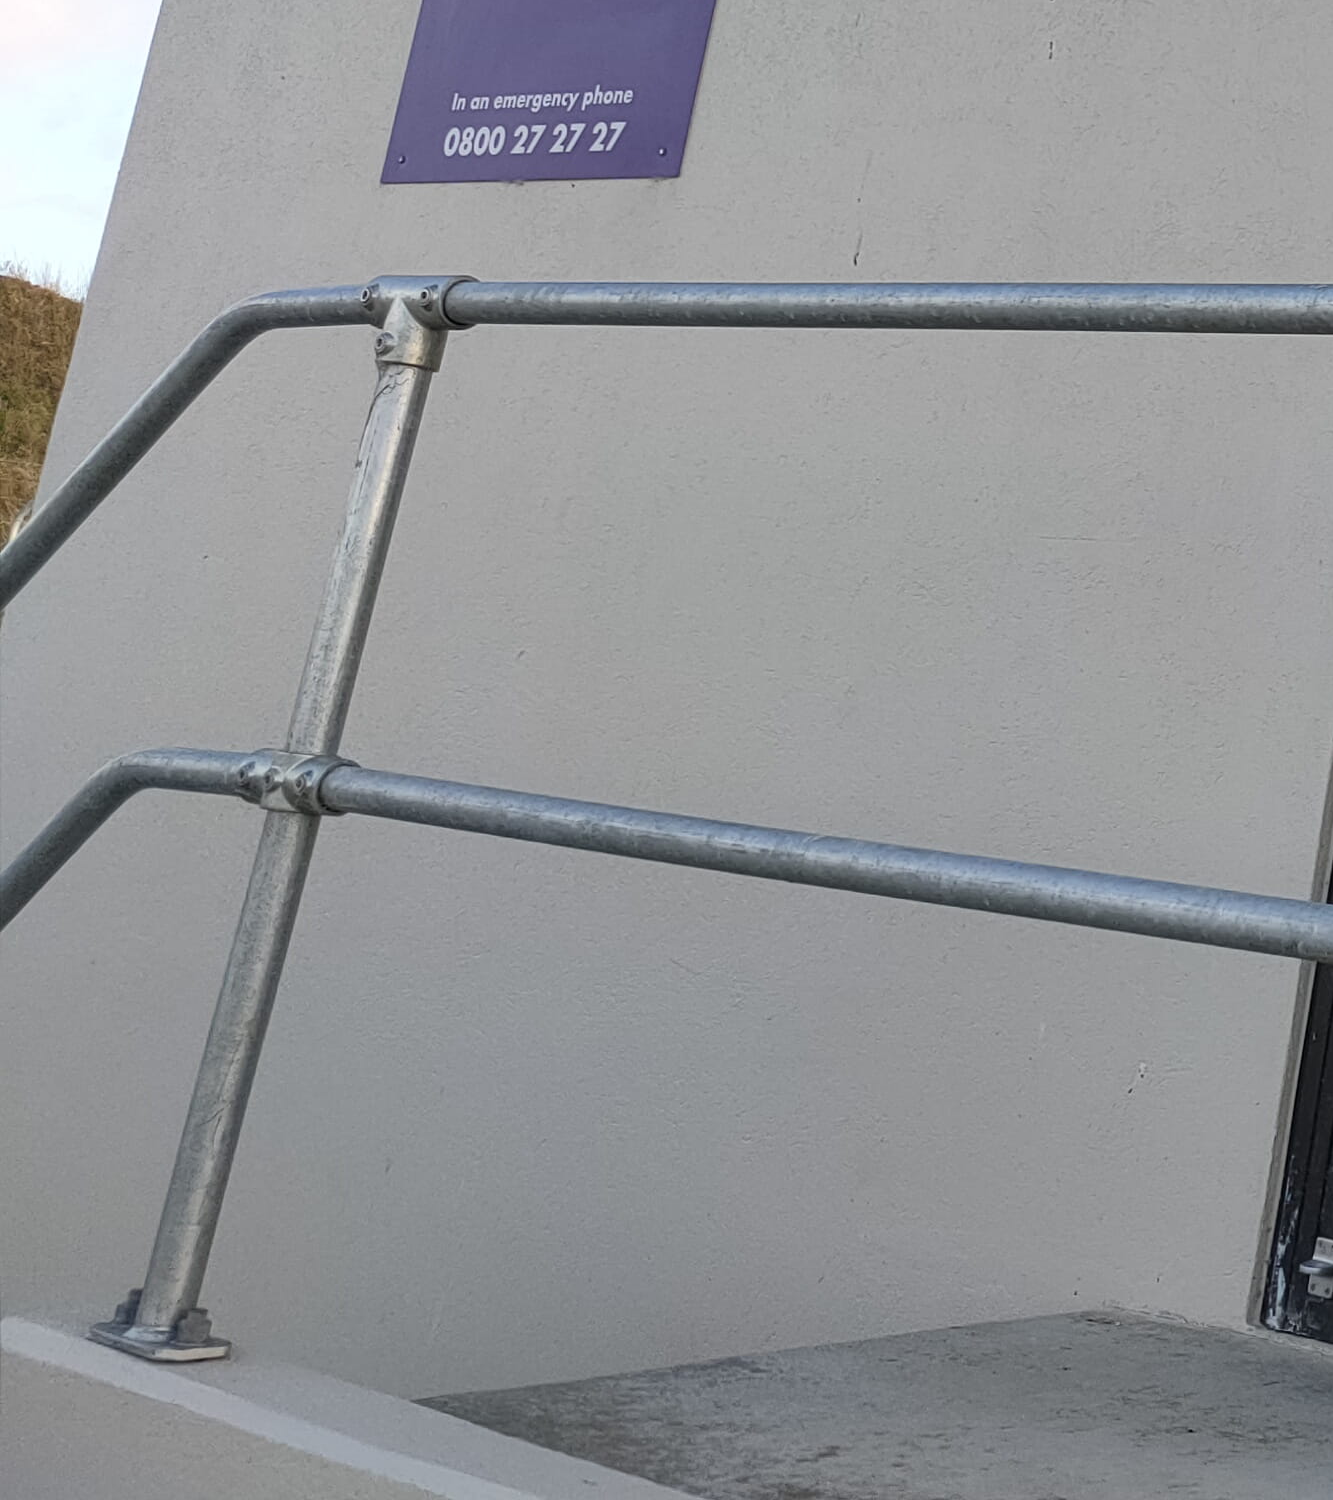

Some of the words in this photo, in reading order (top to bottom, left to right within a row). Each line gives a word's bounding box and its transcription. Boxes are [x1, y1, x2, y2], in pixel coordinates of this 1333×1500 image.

[452, 93, 467, 110] In
[471, 95, 489, 109] an
[493, 90, 579, 113] emergency
[581, 86, 634, 110] phone
[444, 125, 506, 158] 0800
[511, 125, 548, 155] 27
[549, 123, 587, 154] 27
[588, 121, 627, 152] 27
